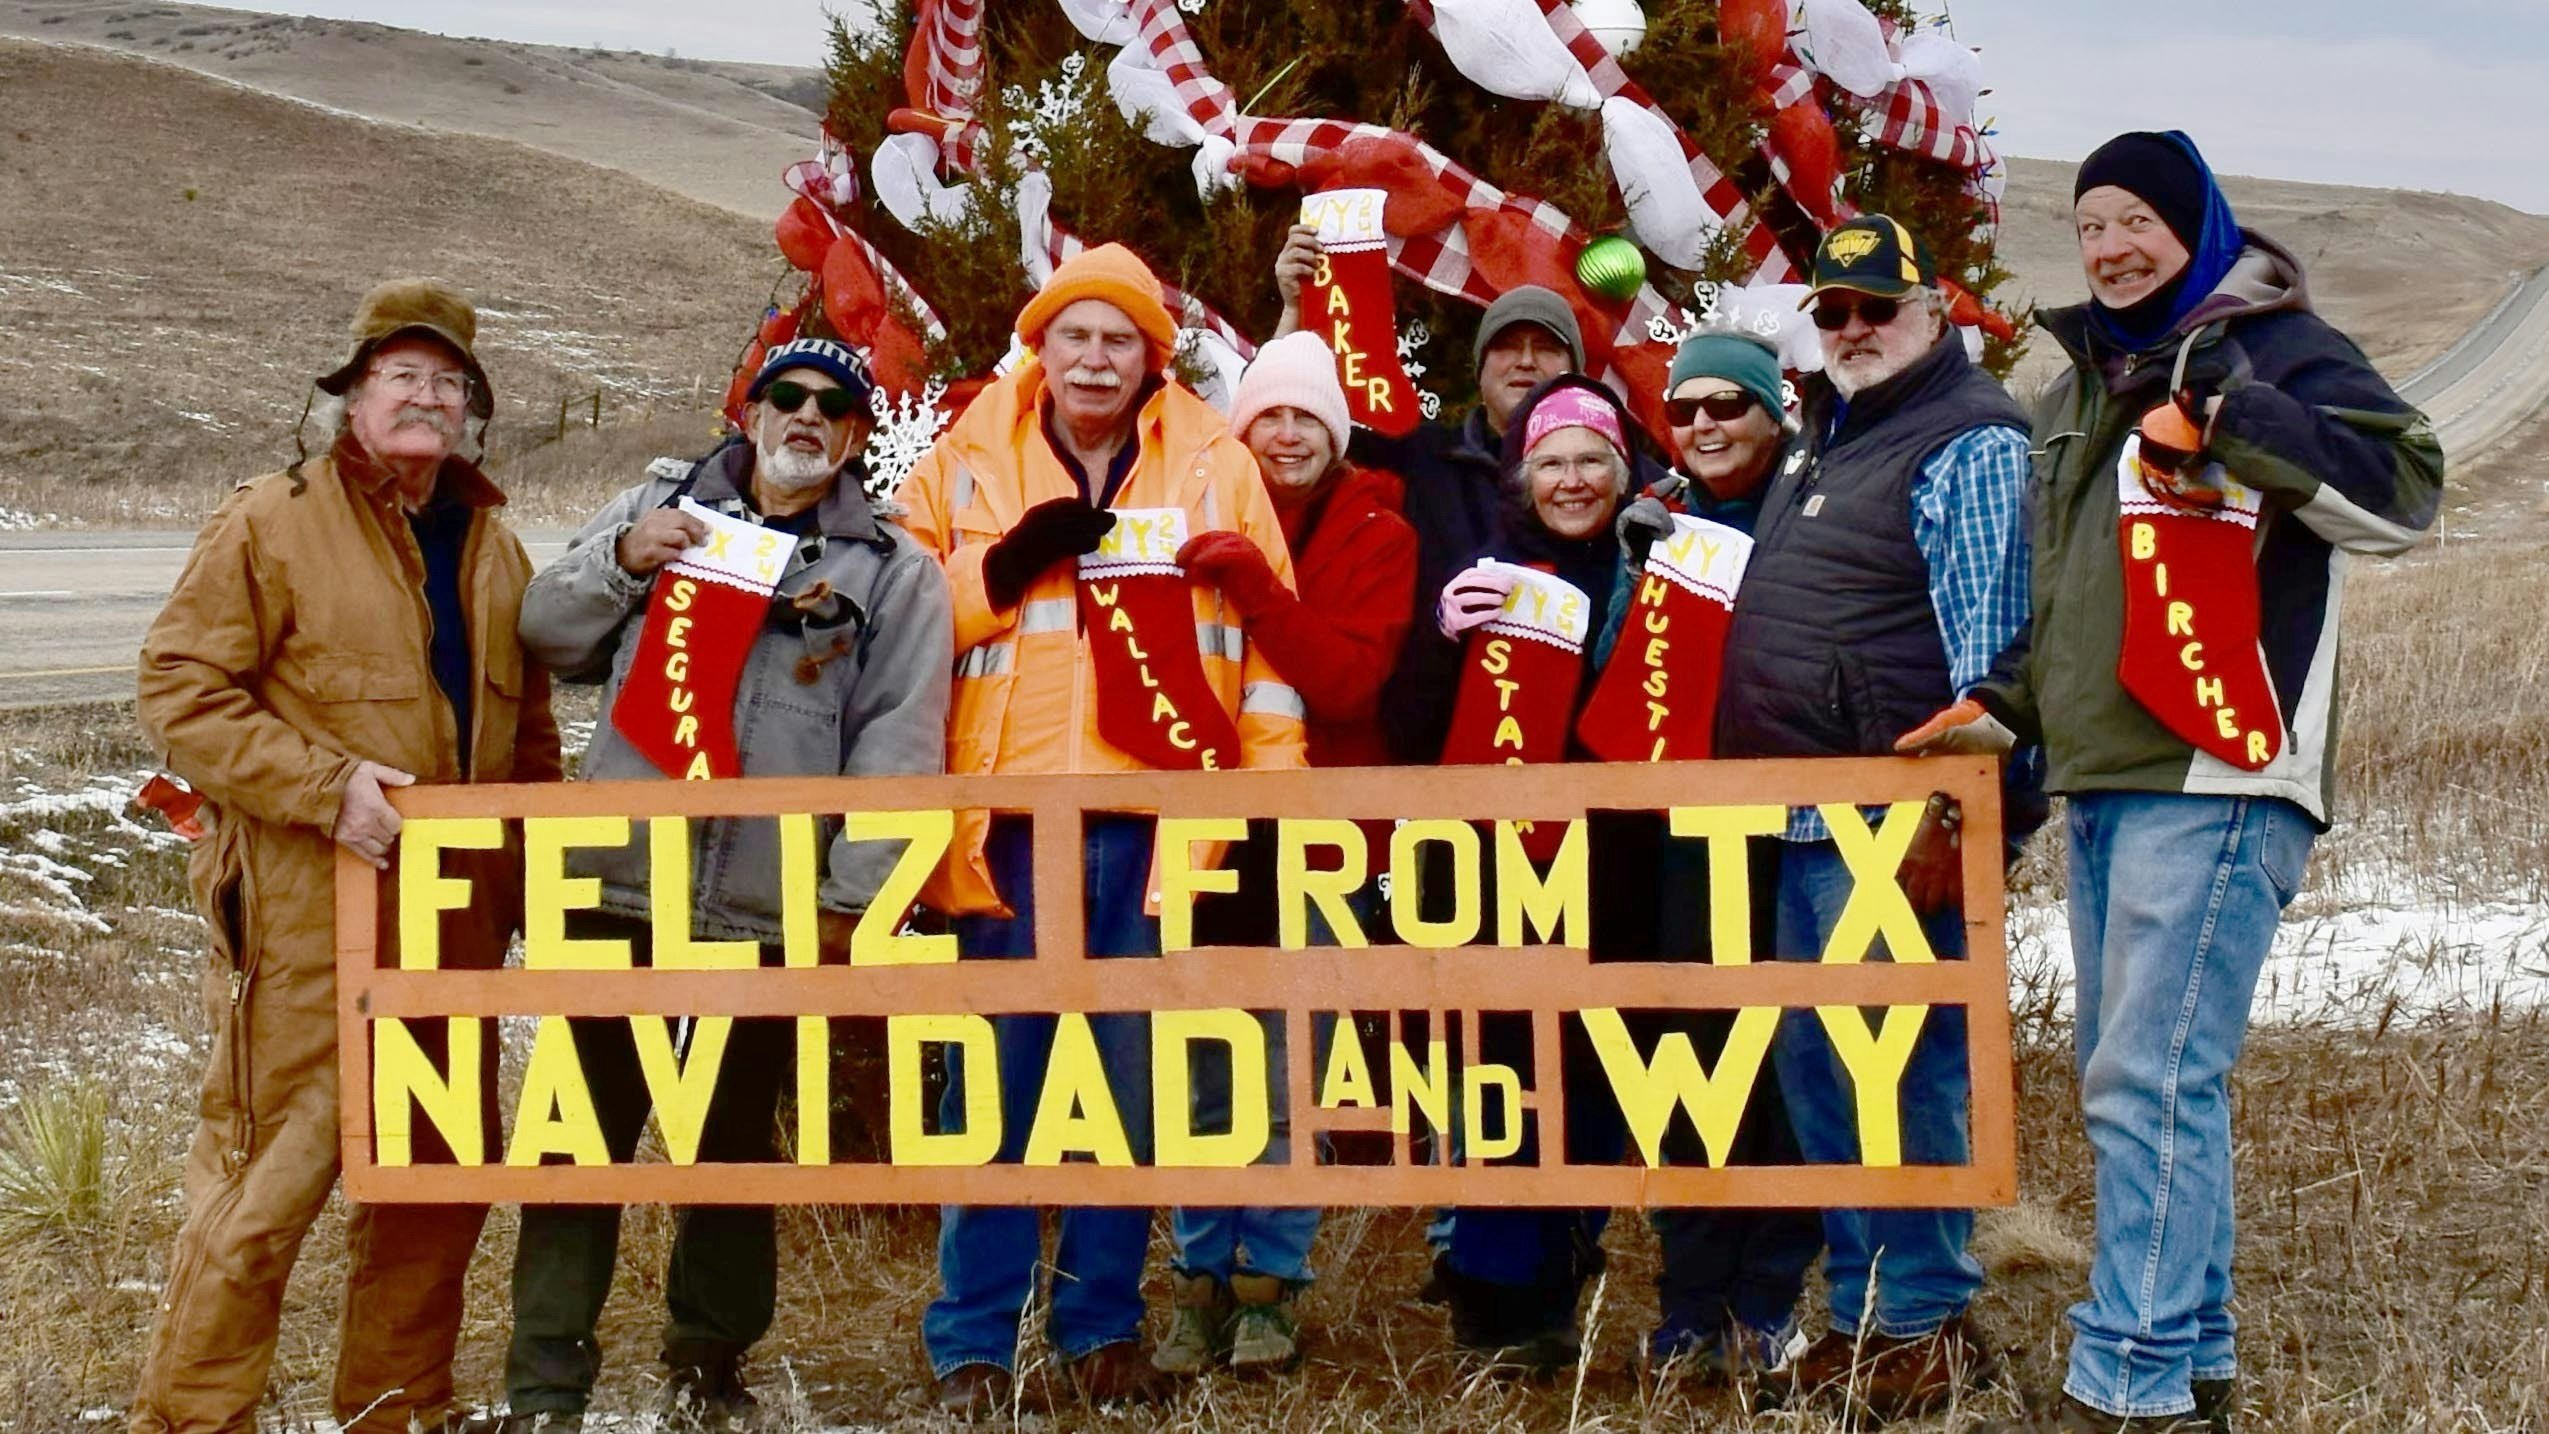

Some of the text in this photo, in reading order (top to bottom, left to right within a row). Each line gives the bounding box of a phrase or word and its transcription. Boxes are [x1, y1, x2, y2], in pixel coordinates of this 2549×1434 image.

[760, 338, 868, 382] olum
[1314, 254, 1392, 412] BAKER
[704, 530, 777, 582] X 24
[665, 580, 710, 781] SEGURA
[1090, 584, 1219, 772] WALLACE
[1482, 640, 1524, 766] STA
[2131, 522, 2270, 763] BIRCHER
[399, 800, 1938, 971] FELIZ FROM TX
[373, 1004, 1930, 1169] NAVIDAD AND WY
